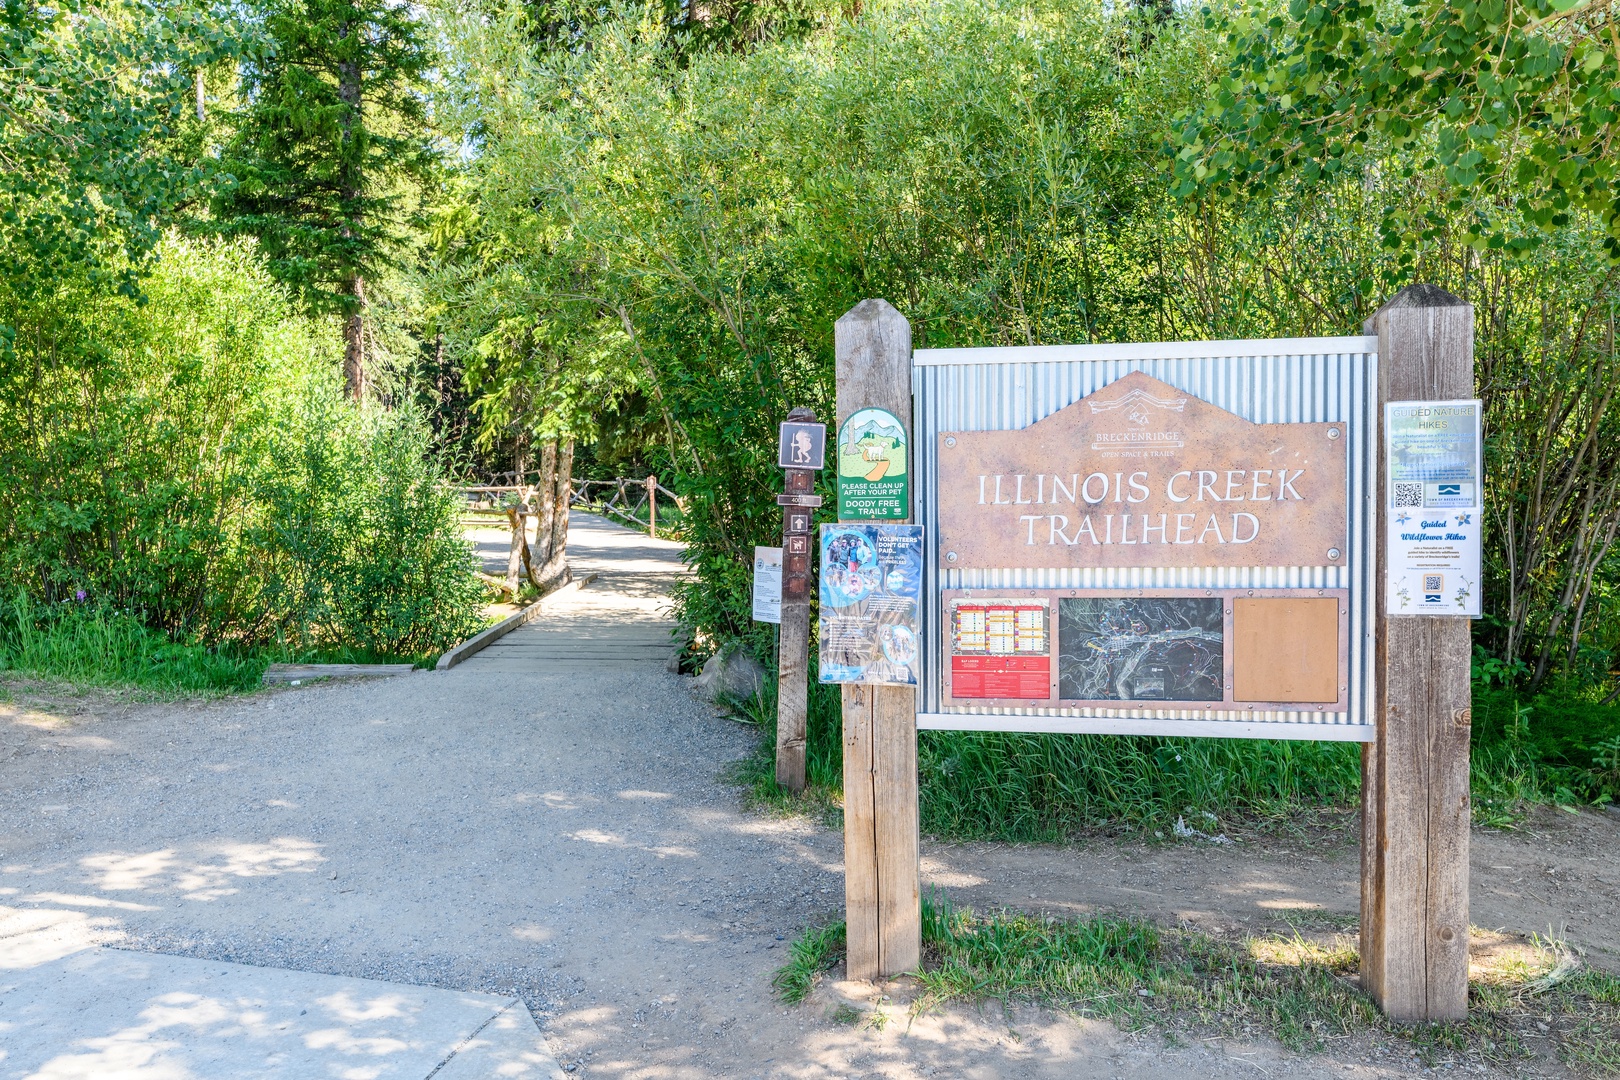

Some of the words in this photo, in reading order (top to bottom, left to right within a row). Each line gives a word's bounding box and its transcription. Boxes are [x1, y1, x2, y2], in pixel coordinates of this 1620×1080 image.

[1393, 408, 1431, 417] GUIDED
[1434, 408, 1474, 416] NATURE
[1096, 432, 1179, 442] BRECKENRIDGE
[977, 472, 1150, 505] ILLINOIS
[1167, 469, 1306, 503] CREEK
[1018, 512, 1260, 546] TRAILHEAD
[1421, 521, 1447, 529] Guided
[1401, 533, 1443, 542] Wildflower
